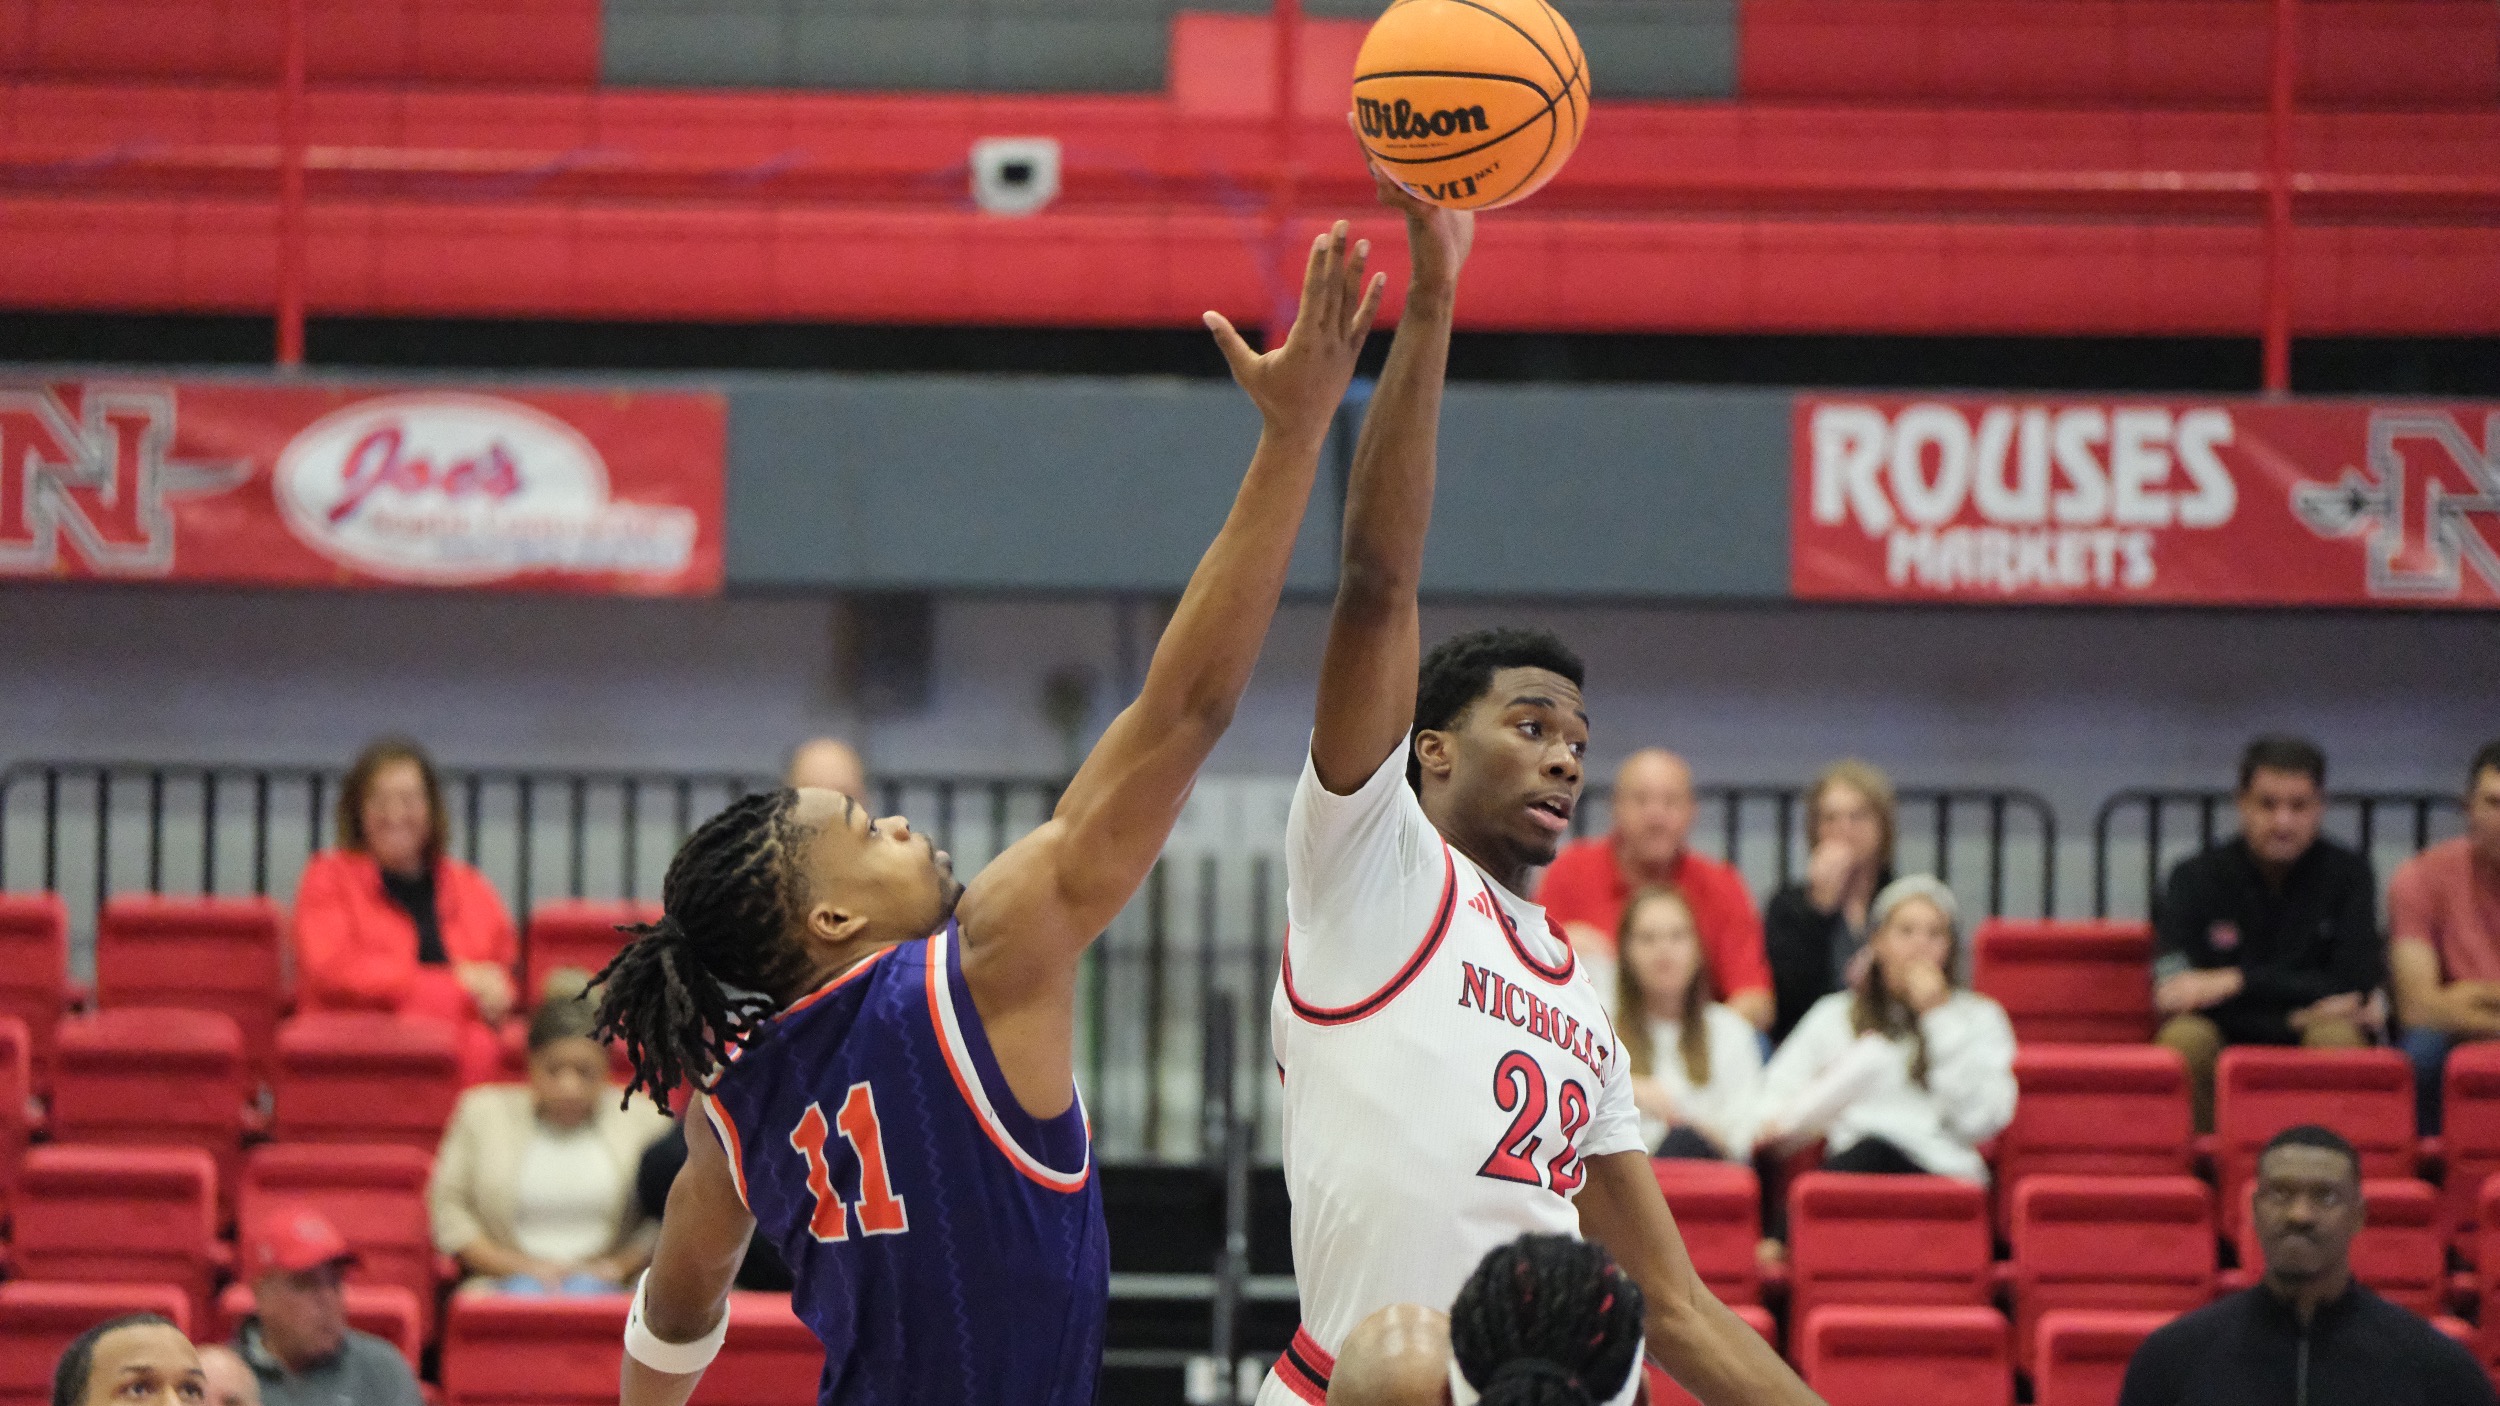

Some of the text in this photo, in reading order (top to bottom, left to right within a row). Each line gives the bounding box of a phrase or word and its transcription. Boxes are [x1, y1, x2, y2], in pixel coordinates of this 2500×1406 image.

[1357, 96, 1490, 139] Wilson
[1810, 402, 2237, 536] ROUSES
[1886, 525, 2154, 593] MARKETS
[789, 1080, 909, 1243] 11
[1476, 1049, 1591, 1198] 22
